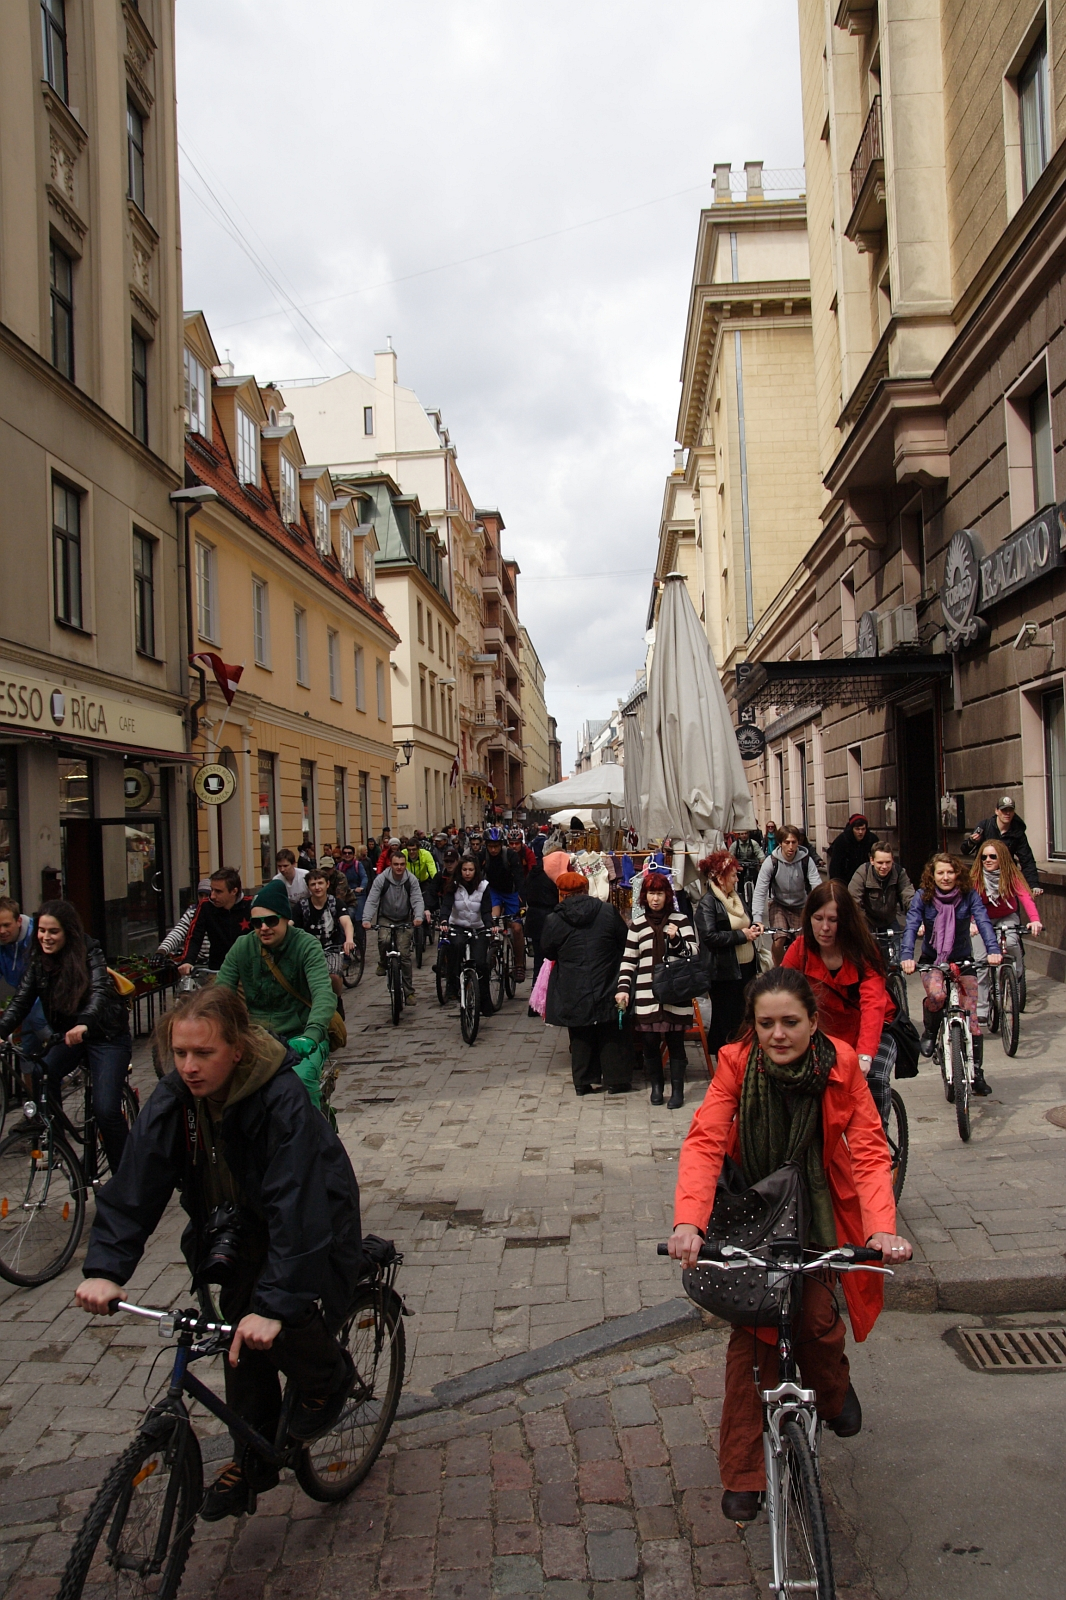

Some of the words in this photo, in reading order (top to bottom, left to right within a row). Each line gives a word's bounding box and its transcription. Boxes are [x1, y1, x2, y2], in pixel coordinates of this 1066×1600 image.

[71, 695, 108, 734] RĪGA
[119, 716, 136, 733] CAFE
[196, 766, 221, 785] ESPRESSO
